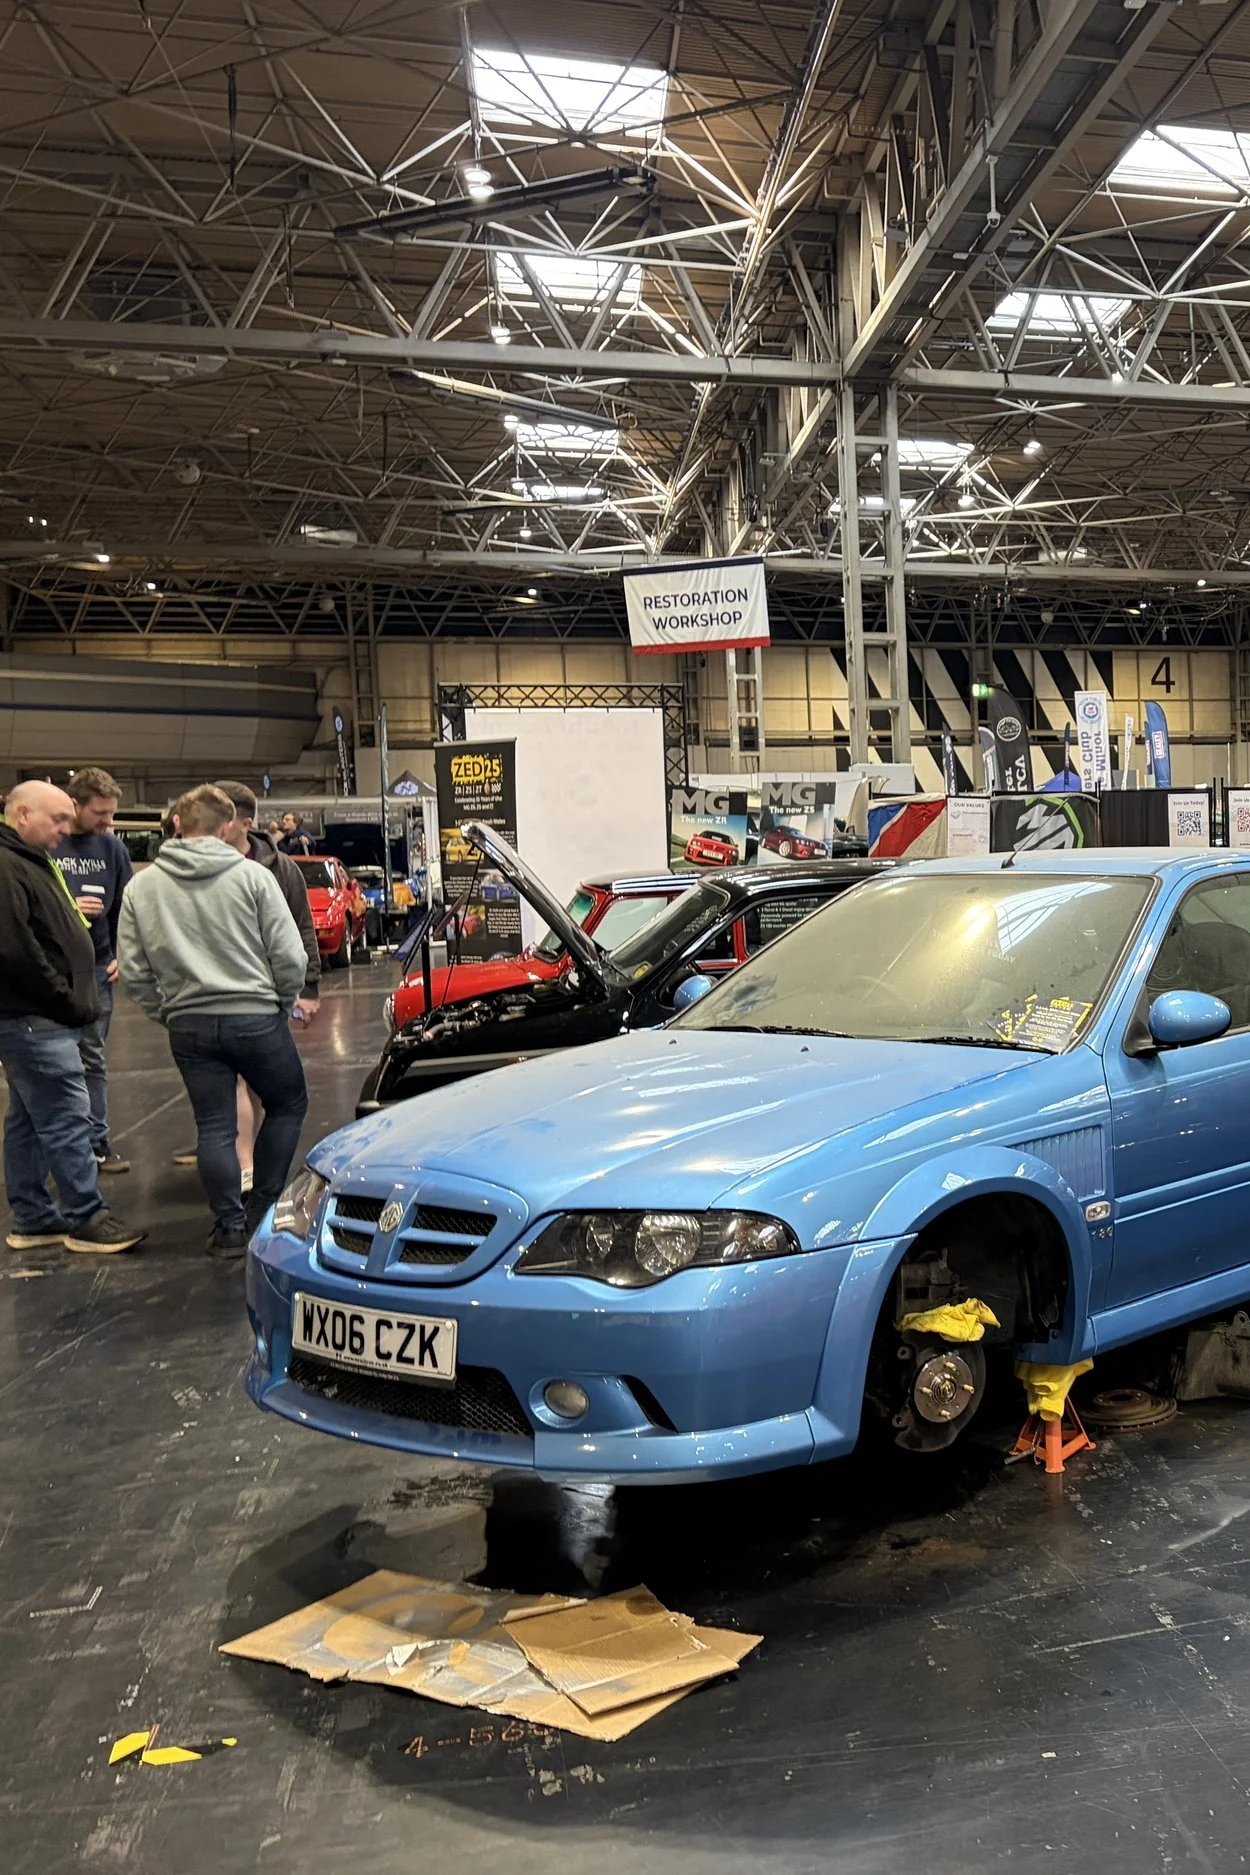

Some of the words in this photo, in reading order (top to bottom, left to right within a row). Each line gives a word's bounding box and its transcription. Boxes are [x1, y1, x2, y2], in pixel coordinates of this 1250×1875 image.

[643, 588, 748, 611] RESTORATION
[652, 610, 743, 632] WORKSHOP
[1151, 656, 1175, 694] 4
[671, 789, 730, 816] MG
[762, 782, 817, 806] MG
[680, 815, 694, 825] The
[715, 816, 727, 824] ZR
[769, 805, 782, 814] The
[786, 806, 802, 814] new
[804, 805, 815, 814] ZS
[303, 1301, 365, 1356] WX06
[375, 1318, 440, 1369] CZK
